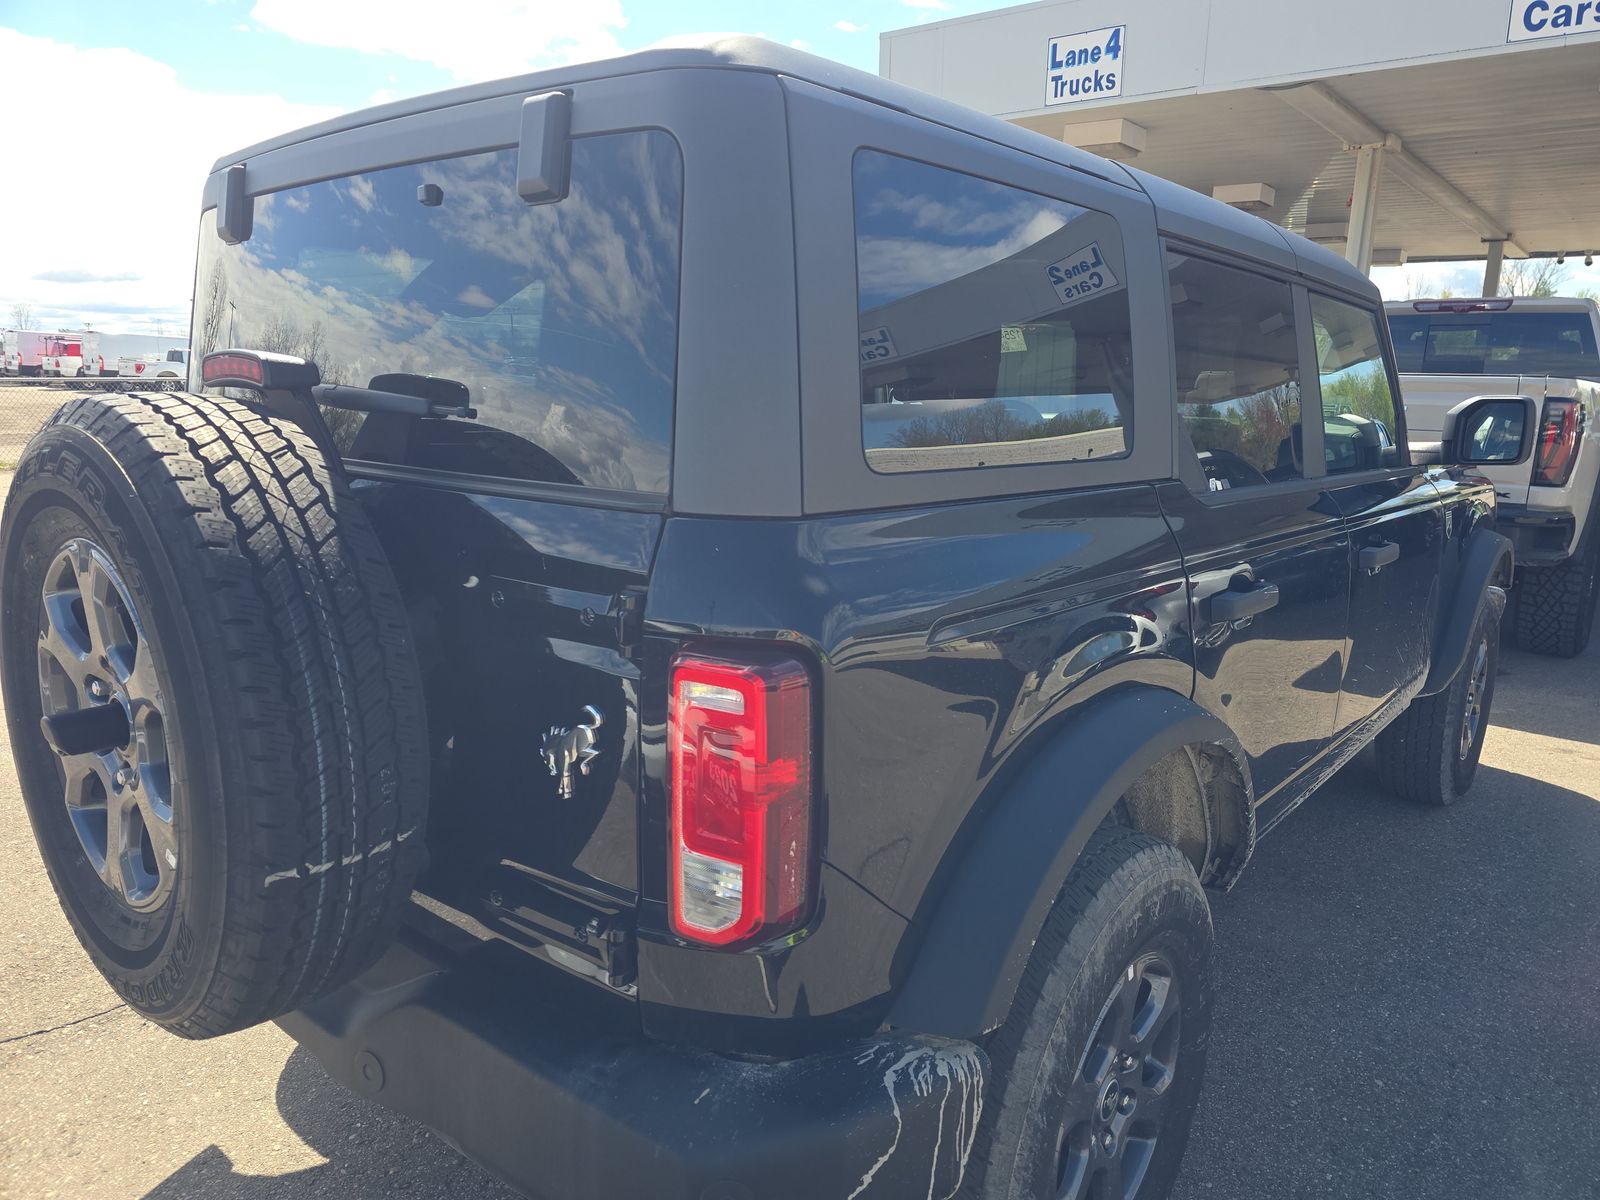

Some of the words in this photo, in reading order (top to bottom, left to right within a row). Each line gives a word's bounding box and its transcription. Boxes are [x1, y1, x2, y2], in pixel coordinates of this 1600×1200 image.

[1049, 42, 1102, 71] Lane
[1104, 27, 1122, 60] 4
[1050, 69, 1117, 99] Trucks
